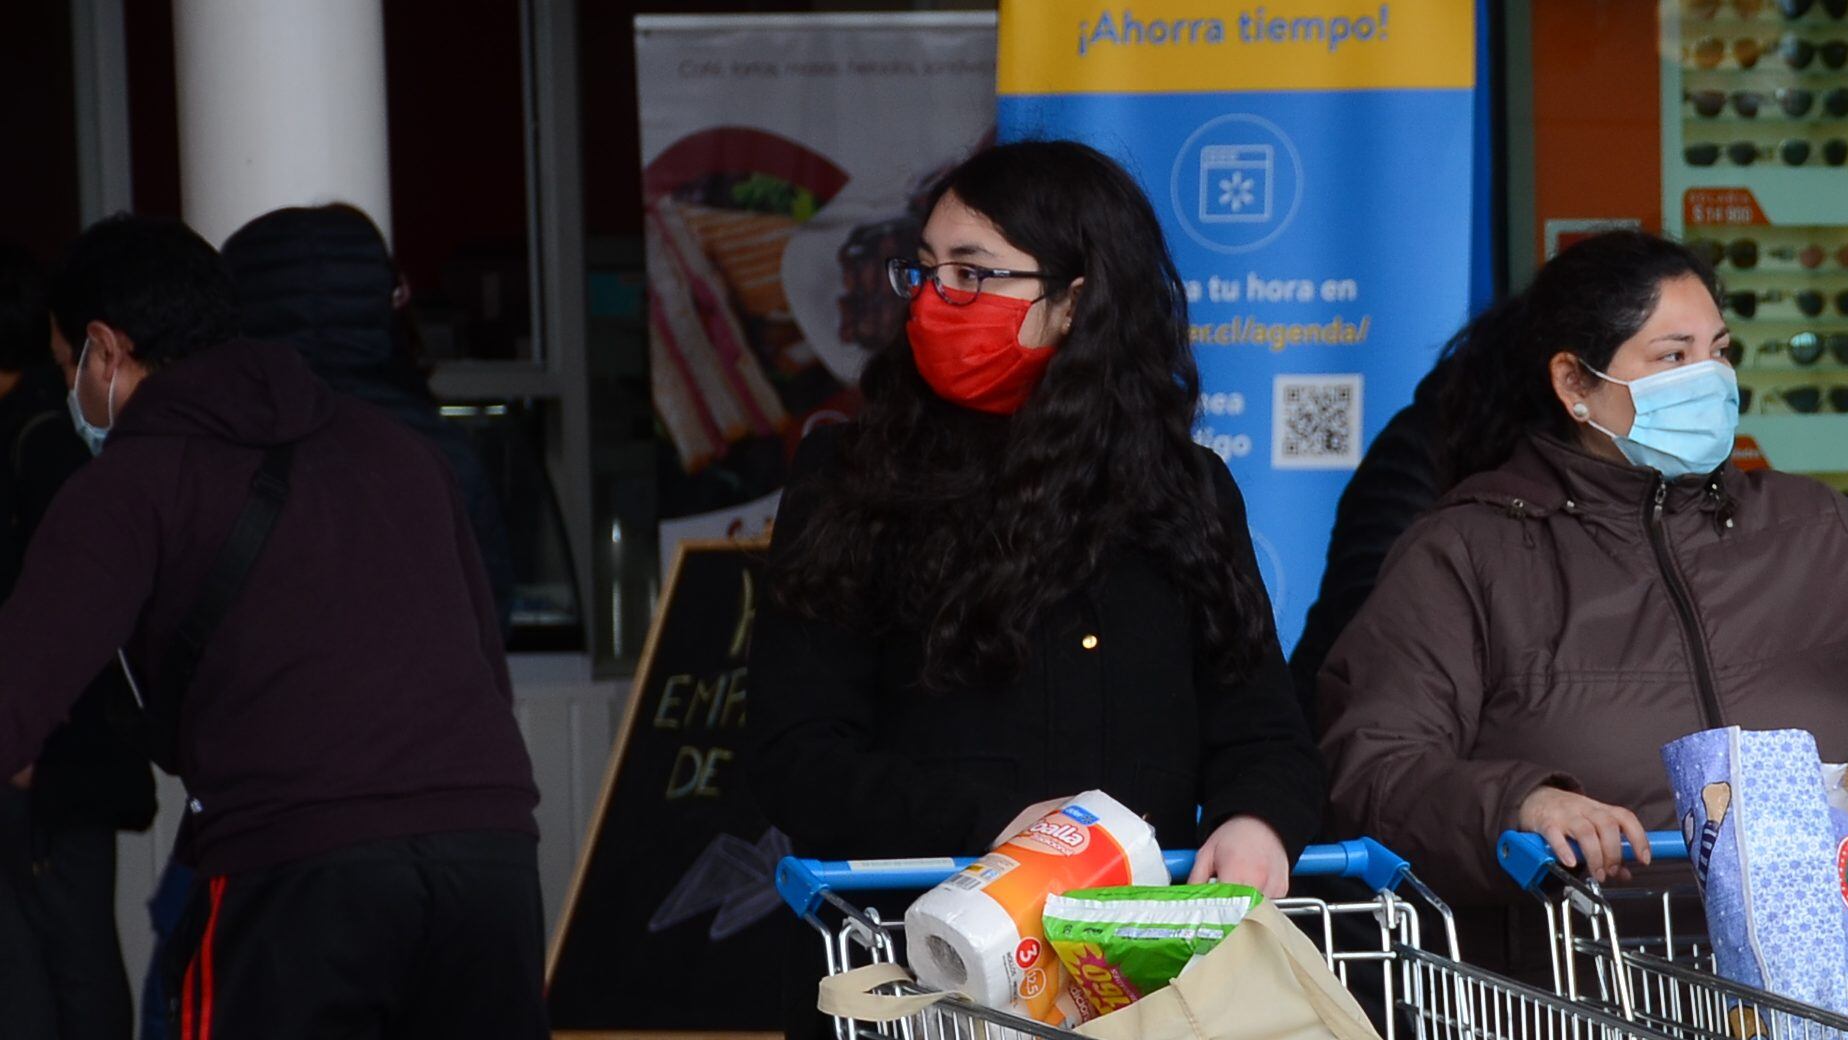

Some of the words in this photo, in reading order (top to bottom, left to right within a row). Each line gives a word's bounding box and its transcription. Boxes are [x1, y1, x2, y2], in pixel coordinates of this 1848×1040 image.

[1076, 9, 1224, 55] ¡Ahorra
[1238, 4, 1388, 53] tiempo!
[1209, 275, 1240, 302] tu
[1247, 271, 1315, 302] hora
[1320, 278, 1357, 301] en
[1189, 315, 1371, 351] er.cl/agenda/
[1029, 820, 1085, 848] oalla
[1018, 942, 1039, 963] 3
